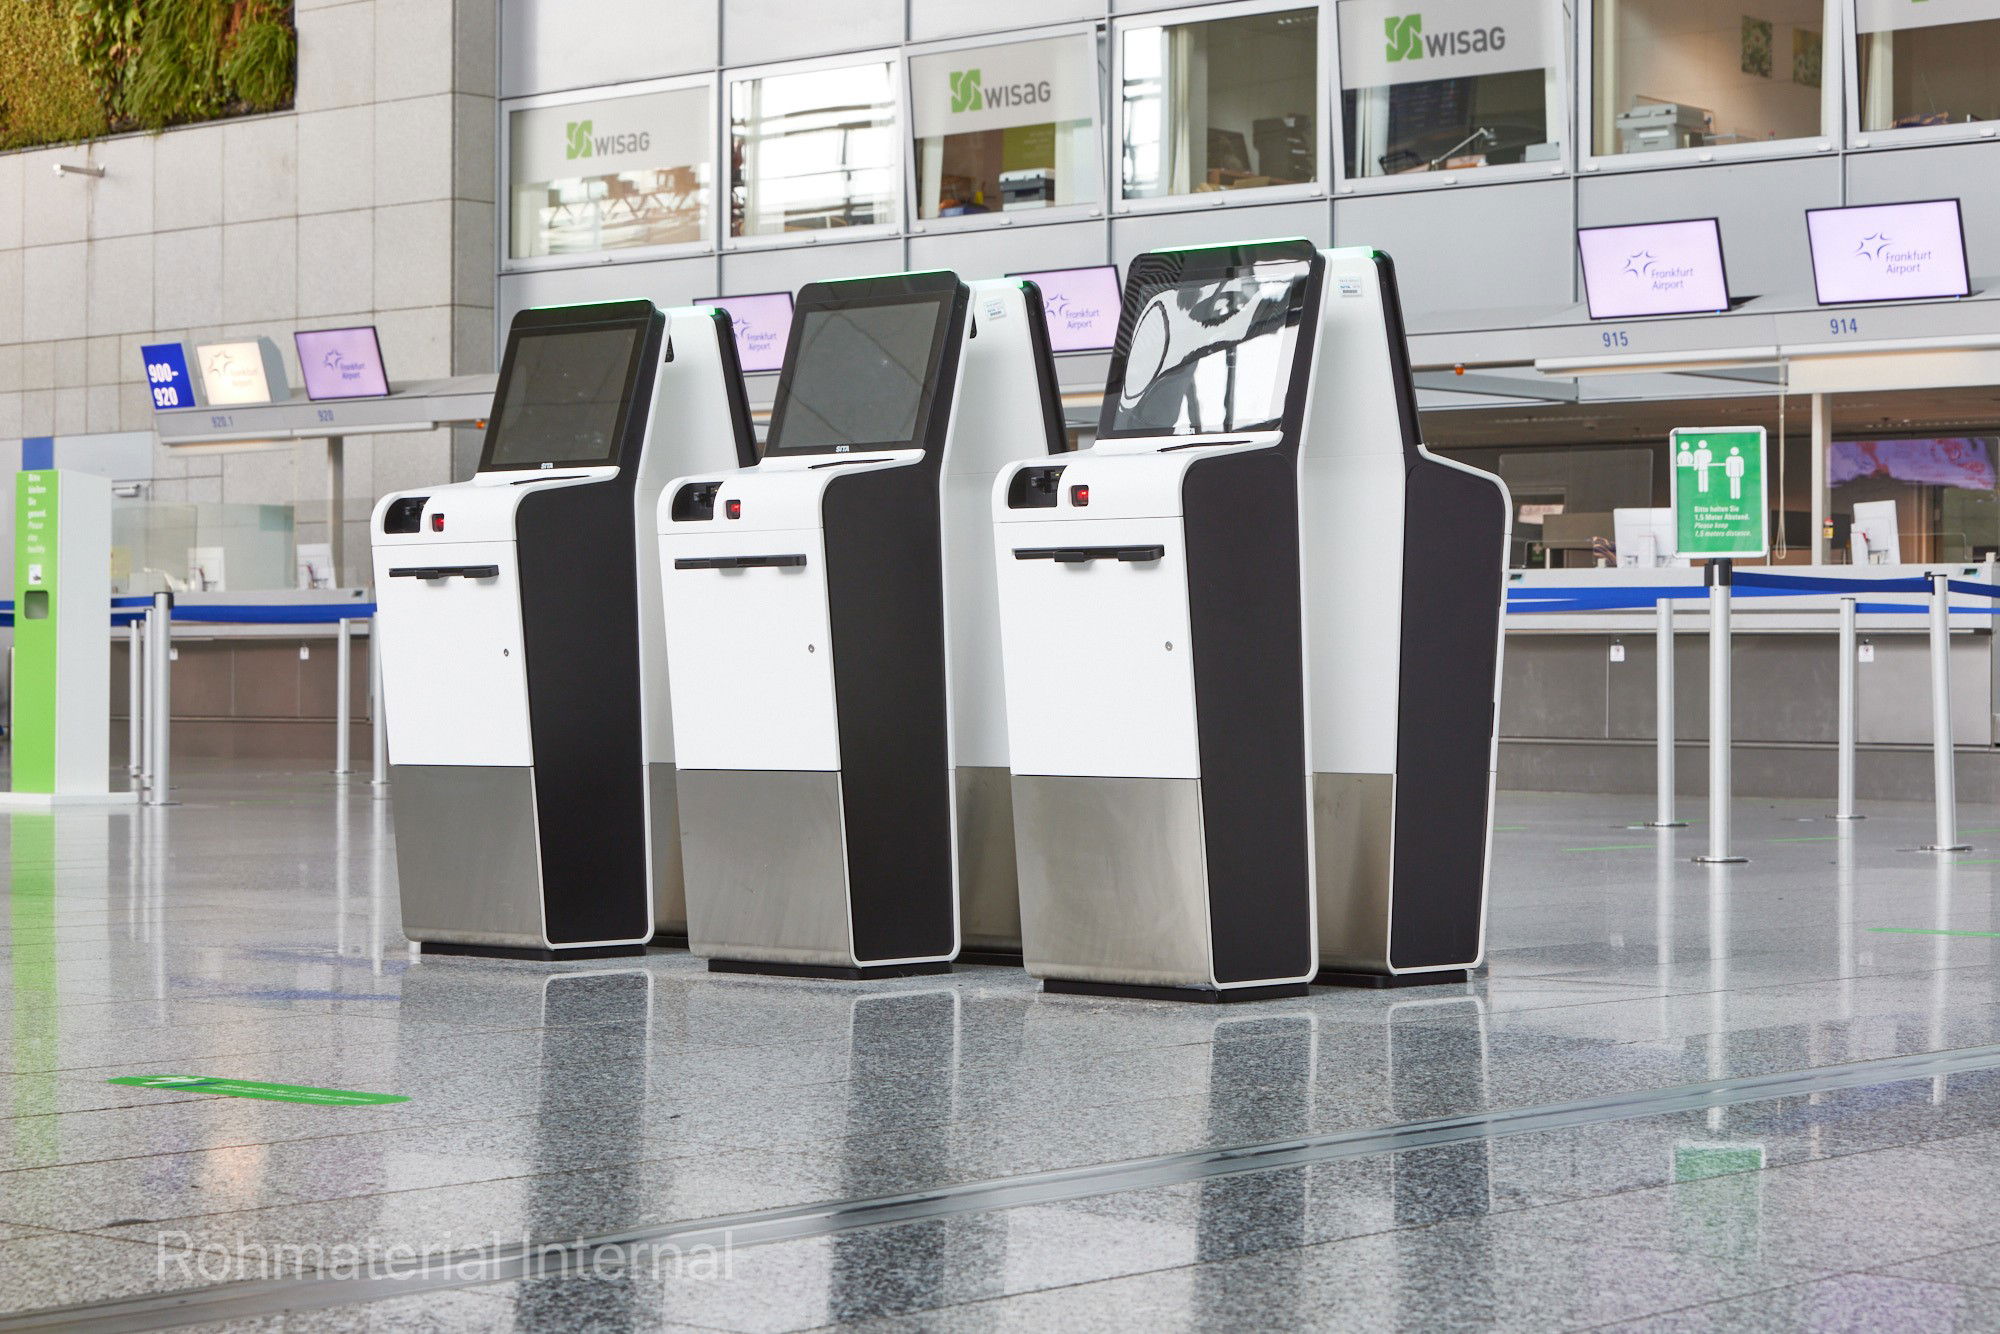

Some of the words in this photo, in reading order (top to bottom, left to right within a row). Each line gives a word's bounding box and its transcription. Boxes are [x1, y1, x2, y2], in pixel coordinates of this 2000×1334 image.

[1886, 251, 1932, 262] Frankfurt
[1651, 267, 1694, 278] Frankfurt
[1886, 263, 1920, 275] Airport
[1652, 279, 1684, 291] Airport
[1065, 308, 1100, 319] Frankfurt
[1066, 320, 1093, 330] Airport
[1829, 317, 1858, 335] 914
[1602, 330, 1629, 348] 915
[148, 363, 179, 383] 900-
[153, 386, 178, 407] 920
[317, 409, 335, 422] 920
